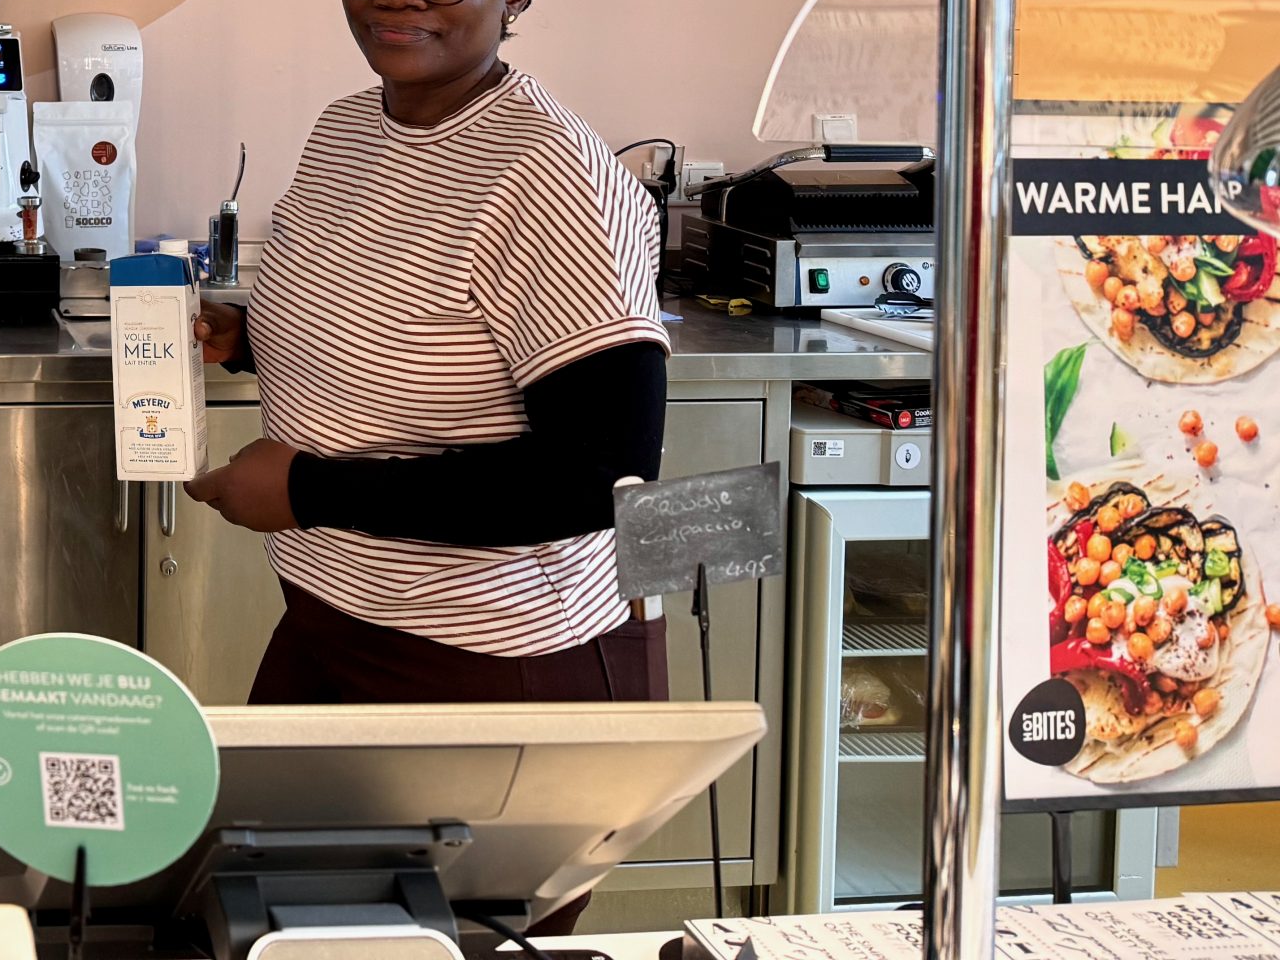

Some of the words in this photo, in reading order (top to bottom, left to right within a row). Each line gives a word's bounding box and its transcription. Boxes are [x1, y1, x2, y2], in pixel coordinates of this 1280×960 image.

[1015, 181, 1151, 214] WARME
[75, 217, 113, 226] SOCOCO
[124, 333, 152, 342] VOLLE
[124, 342, 175, 359] MELK
[726, 554, 773, 577] 4.95
[67, 673, 94, 687] WE
[95, 674, 115, 688] JE
[117, 675, 151, 690] BLIJ
[69, 693, 163, 709] VANDAAG?
[1022, 712, 1033, 742] HOT
[1032, 709, 1076, 742] BITES
